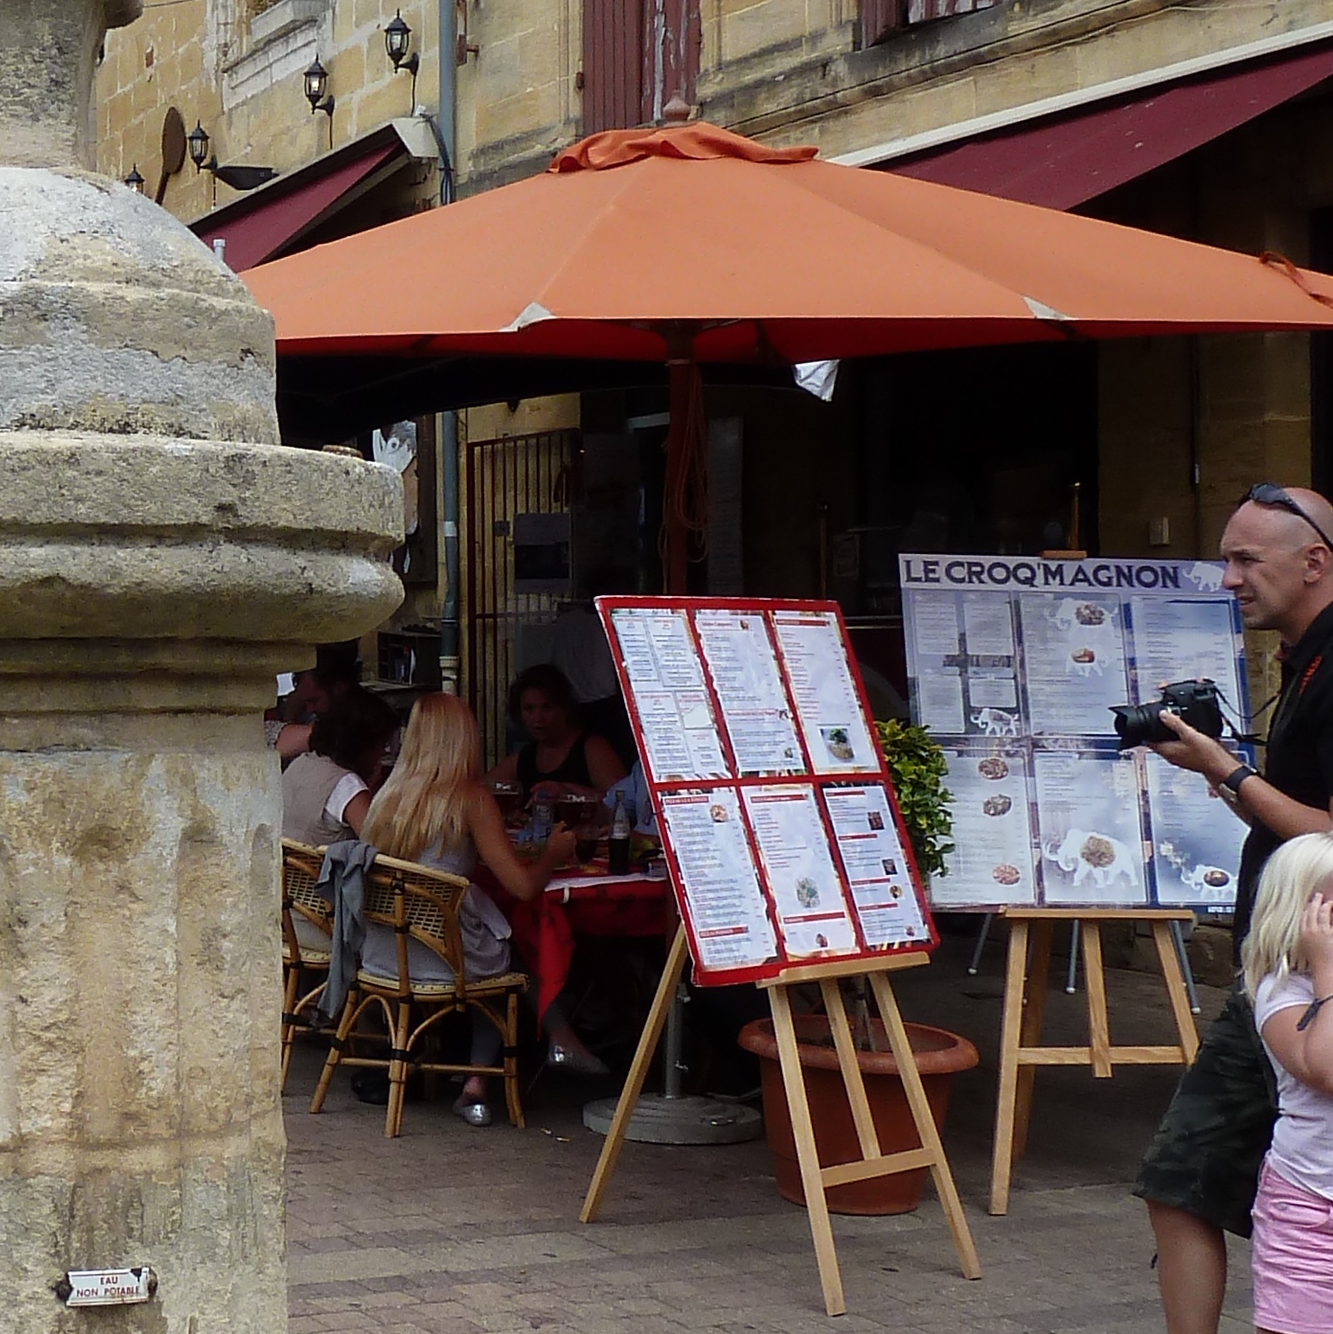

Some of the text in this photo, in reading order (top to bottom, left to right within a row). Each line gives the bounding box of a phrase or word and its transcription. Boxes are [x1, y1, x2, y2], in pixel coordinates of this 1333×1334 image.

[904, 560, 940, 583] LE
[100, 1276, 119, 1285] EAU
[76, 1285, 140, 1297] NON POTABLE
